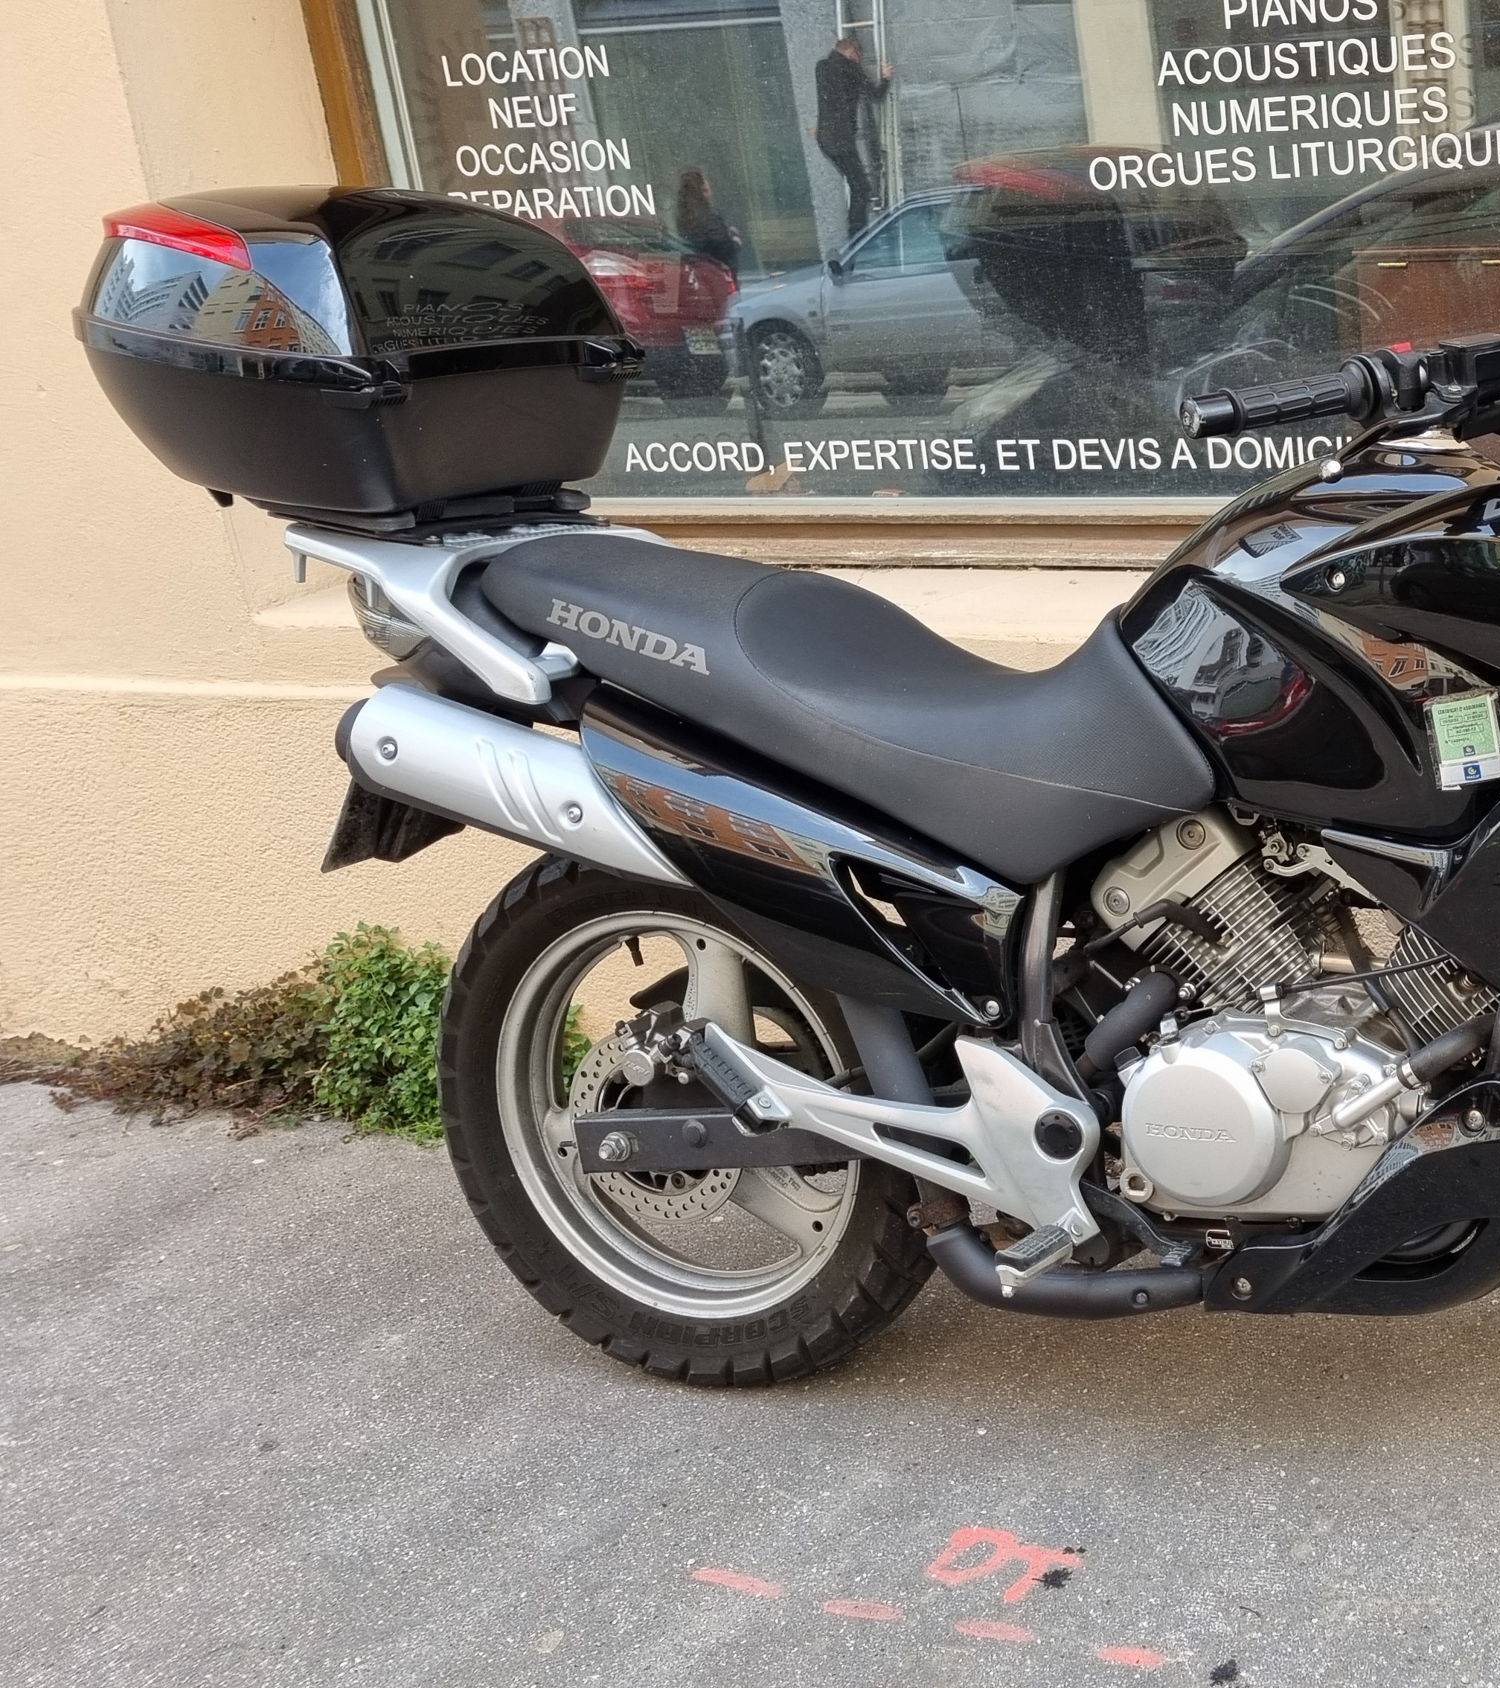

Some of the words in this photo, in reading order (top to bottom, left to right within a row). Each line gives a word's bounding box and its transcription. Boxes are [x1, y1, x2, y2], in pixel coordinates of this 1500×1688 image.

[1224, 0, 1378, 30] PIANOS
[440, 44, 611, 88] LOCATION
[1157, 31, 1457, 87] ACOUSTIQUES
[487, 92, 577, 129] NEUF
[1171, 85, 1449, 137] NUMERIQUES
[455, 137, 632, 177] OCCASION
[1088, 145, 1257, 192] ORGUES
[447, 183, 656, 220] EPARATION
[625, 441, 775, 476] ACCORD,
[783, 438, 987, 476] EXPERTISE,
[996, 438, 1041, 471] ET
[1051, 437, 1162, 471] DEVIS
[1170, 437, 1198, 470] A
[546, 598, 711, 676] HONDA
[1144, 1122, 1238, 1143] HONDA
